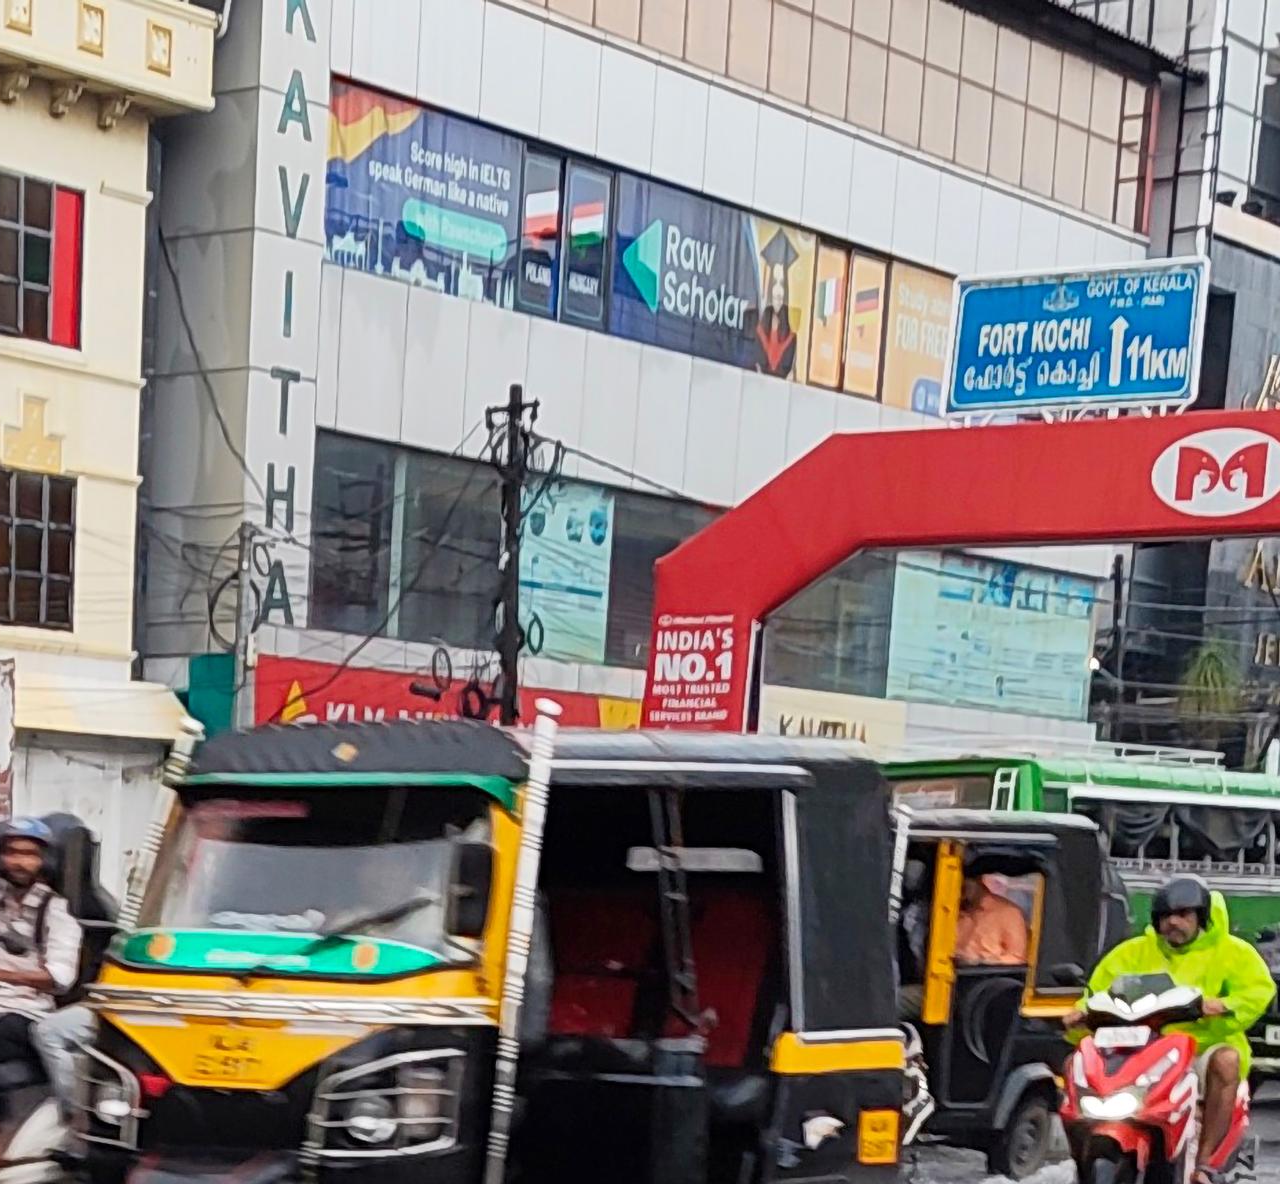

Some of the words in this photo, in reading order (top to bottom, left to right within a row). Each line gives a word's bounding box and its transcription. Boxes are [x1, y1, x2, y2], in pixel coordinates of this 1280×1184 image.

[410, 142, 443, 171] Score
[444, 152, 467, 179] high
[468, 158, 480, 180] in
[480, 162, 511, 191] IELTS
[369, 160, 403, 186] speak
[404, 167, 447, 199] German
[447, 178, 467, 203] like
[468, 190, 475, 204] a
[476, 191, 509, 217] native
[665, 225, 717, 275] Raw
[663, 274, 749, 331] Scholar
[1124, 277, 1141, 295] OF
[1143, 274, 1192, 293] KERALA
[978, 321, 1029, 357] FORT
[1031, 316, 1092, 353] KOCHI
[1036, 350, 1101, 392] കൊച്ചി
[656, 627, 734, 651] INDIA'S
[654, 650, 733, 682] NO.1
[652, 683, 682, 696] MOST
[685, 682, 731, 695] TRUSTED
[662, 697, 718, 709] FINANCIAL
[649, 710, 692, 722] SERVICES
[694, 708, 728, 721] BRAND
